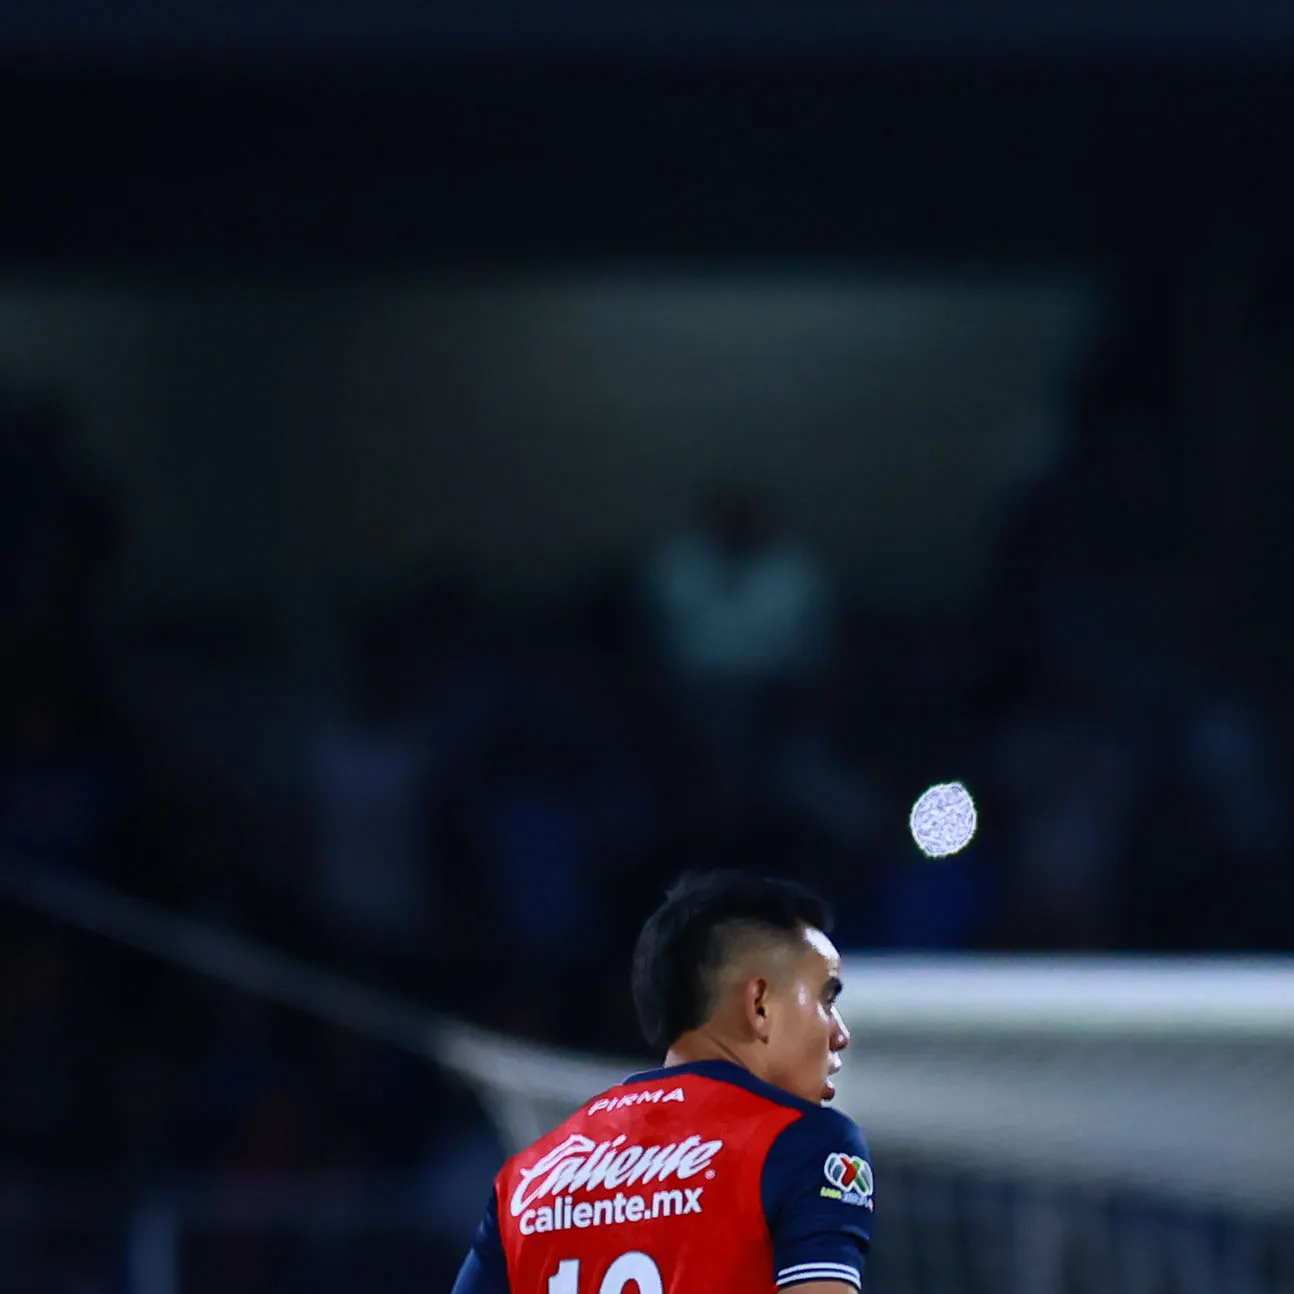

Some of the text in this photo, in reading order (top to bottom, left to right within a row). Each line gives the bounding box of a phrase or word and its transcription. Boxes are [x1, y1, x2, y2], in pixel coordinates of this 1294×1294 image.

[587, 1087, 685, 1116] PIRMA
[510, 1134, 723, 1217] Caliente
[519, 1187, 703, 1236] caliente.mx
